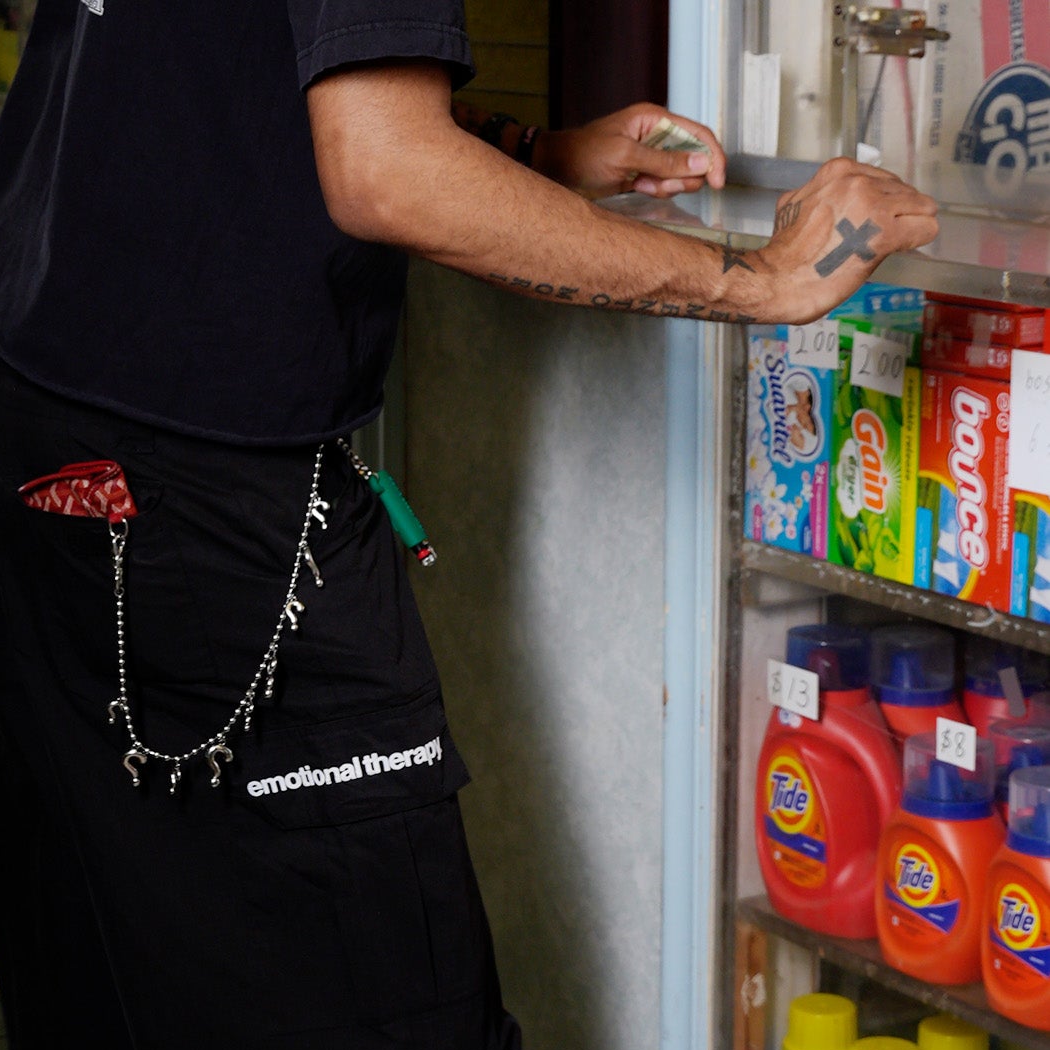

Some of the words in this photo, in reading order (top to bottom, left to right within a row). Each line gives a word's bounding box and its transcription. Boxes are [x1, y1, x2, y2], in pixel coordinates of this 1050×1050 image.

[765, 354, 791, 463] Suavitel
[853, 410, 888, 511] Gain
[949, 388, 988, 568] bounce
[247, 757, 363, 797] emotional
[770, 771, 810, 815] Tide
[897, 857, 934, 892] Tide
[999, 896, 1036, 935] Tide
